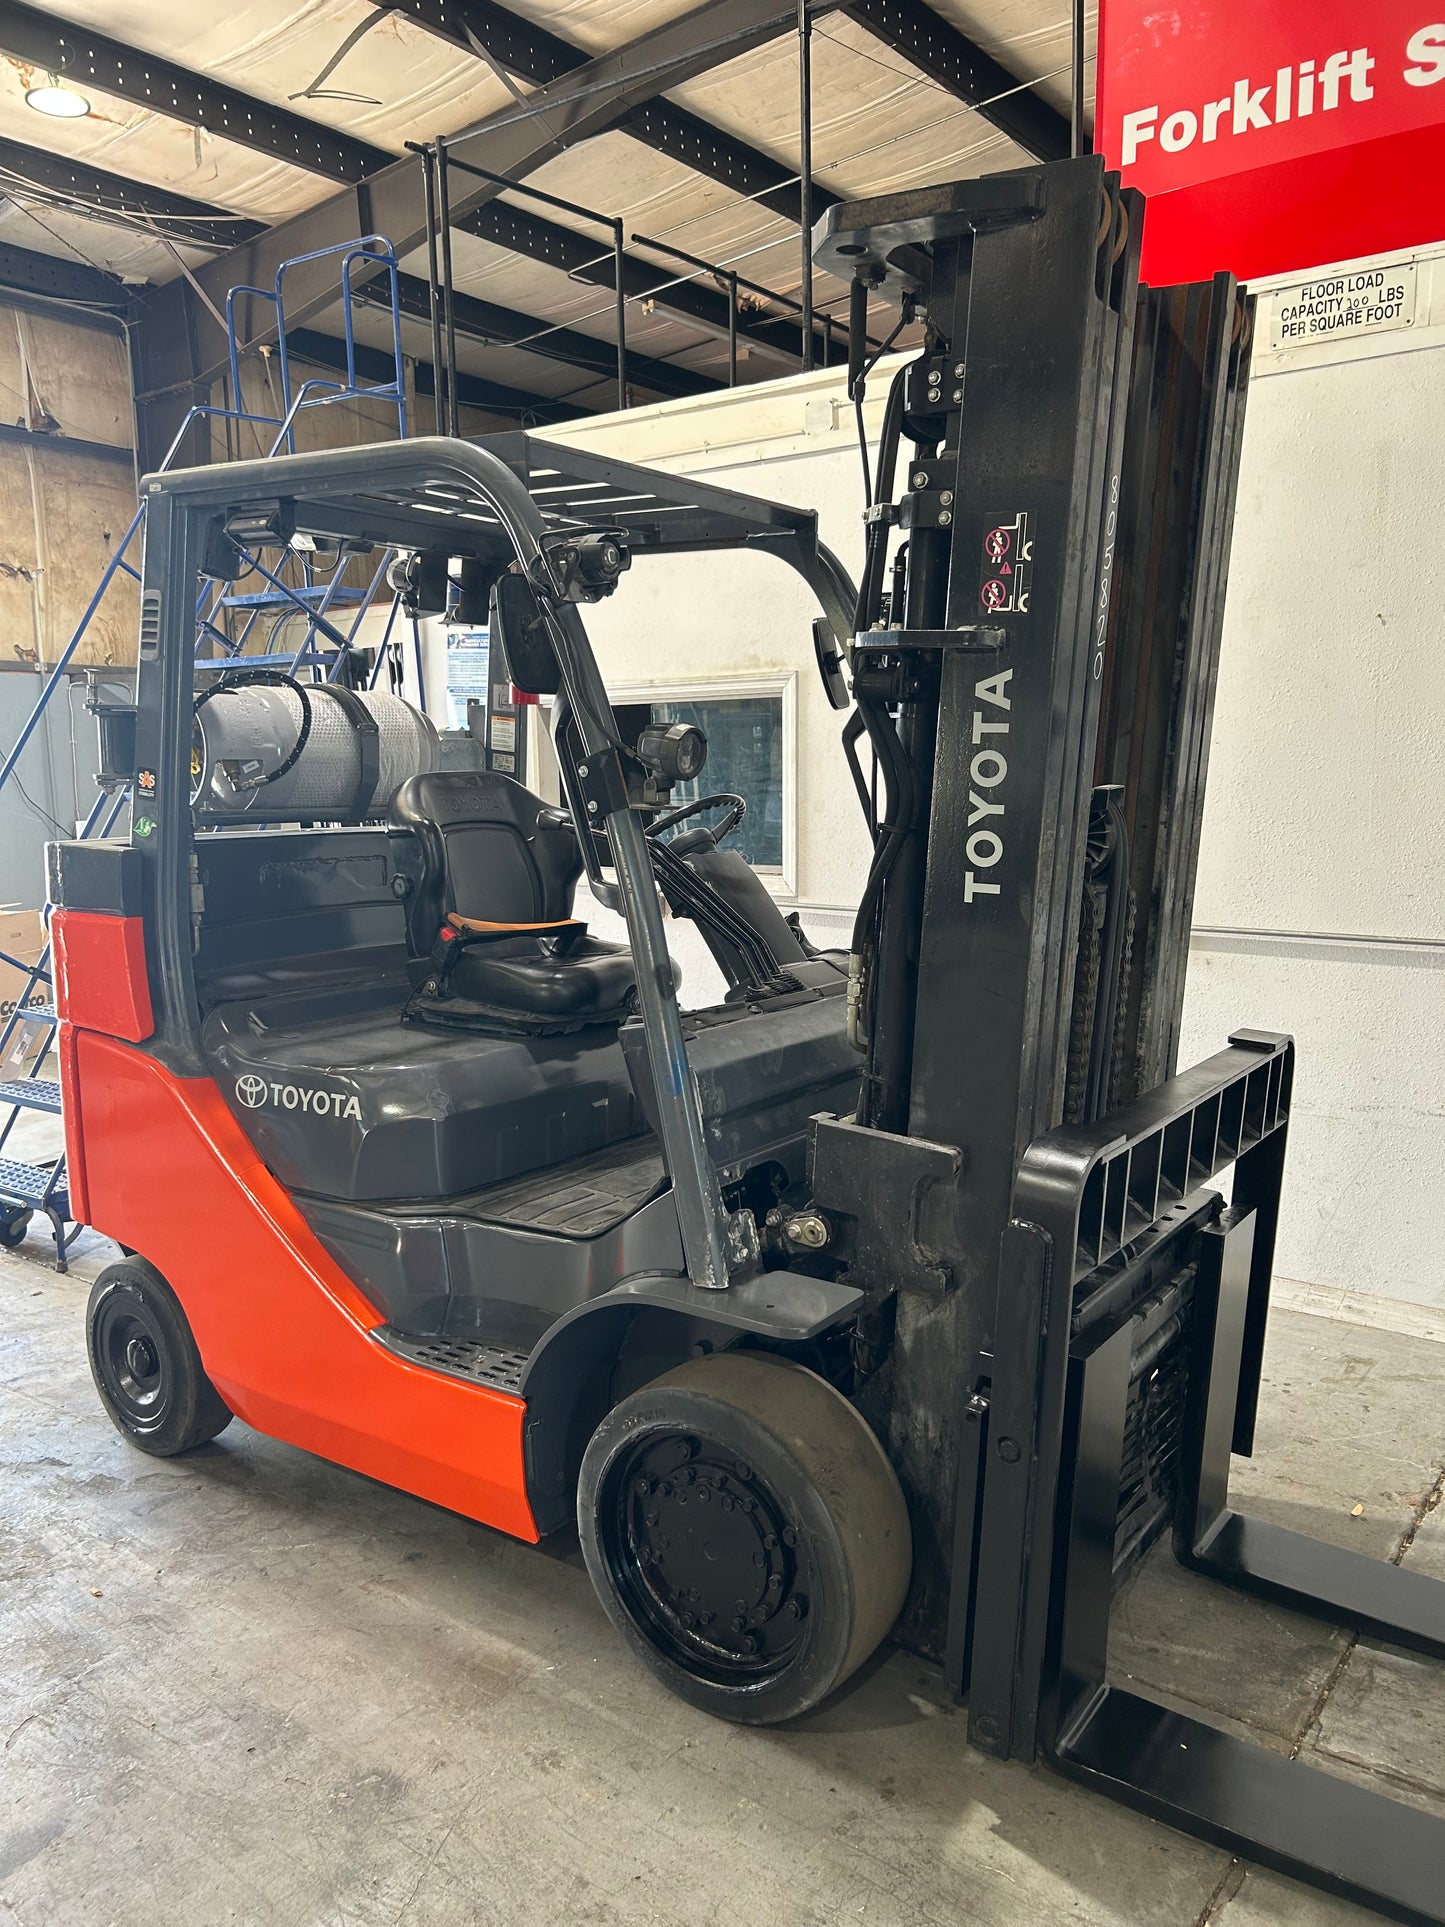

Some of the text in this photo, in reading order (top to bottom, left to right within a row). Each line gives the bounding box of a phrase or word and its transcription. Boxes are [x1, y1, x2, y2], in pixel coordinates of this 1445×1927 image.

[1121, 47, 1376, 167] Forklift
[1281, 297, 1344, 322] CAPACITY
[1378, 285, 1405, 304] LBS
[1301, 272, 1384, 302] FLOOR LOAD
[1281, 303, 1403, 338] PER SQUARE FOOT
[1093, 475, 1118, 680] 805820
[138, 770, 156, 789] SAS
[963, 668, 1014, 903] TOYOTA
[0, 995, 45, 1016] COCO
[270, 1083, 362, 1120] TOYOTA
